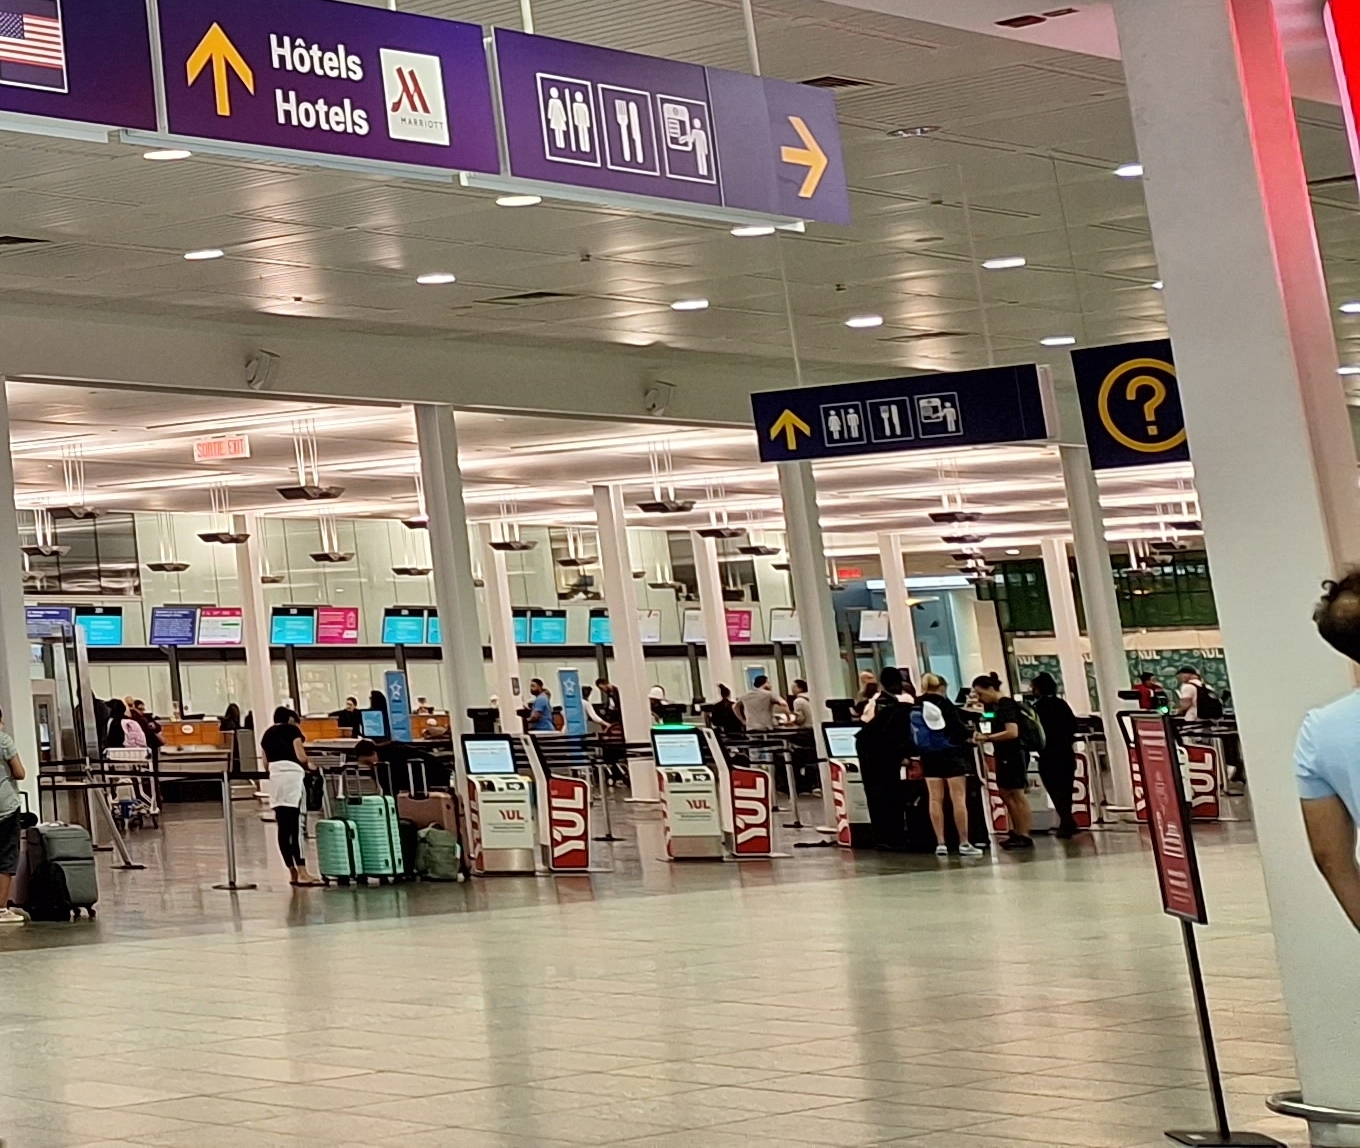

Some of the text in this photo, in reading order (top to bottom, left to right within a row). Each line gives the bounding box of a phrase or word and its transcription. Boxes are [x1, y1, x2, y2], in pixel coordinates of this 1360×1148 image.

[269, 34, 364, 82] Hôtels
[274, 87, 371, 137] Hotels
[400, 115, 445, 131] MARRIOTT
[498, 809, 525, 821] YUL
[551, 786, 586, 859] YUL
[685, 799, 711, 810] YUL
[733, 777, 768, 845] YUL
